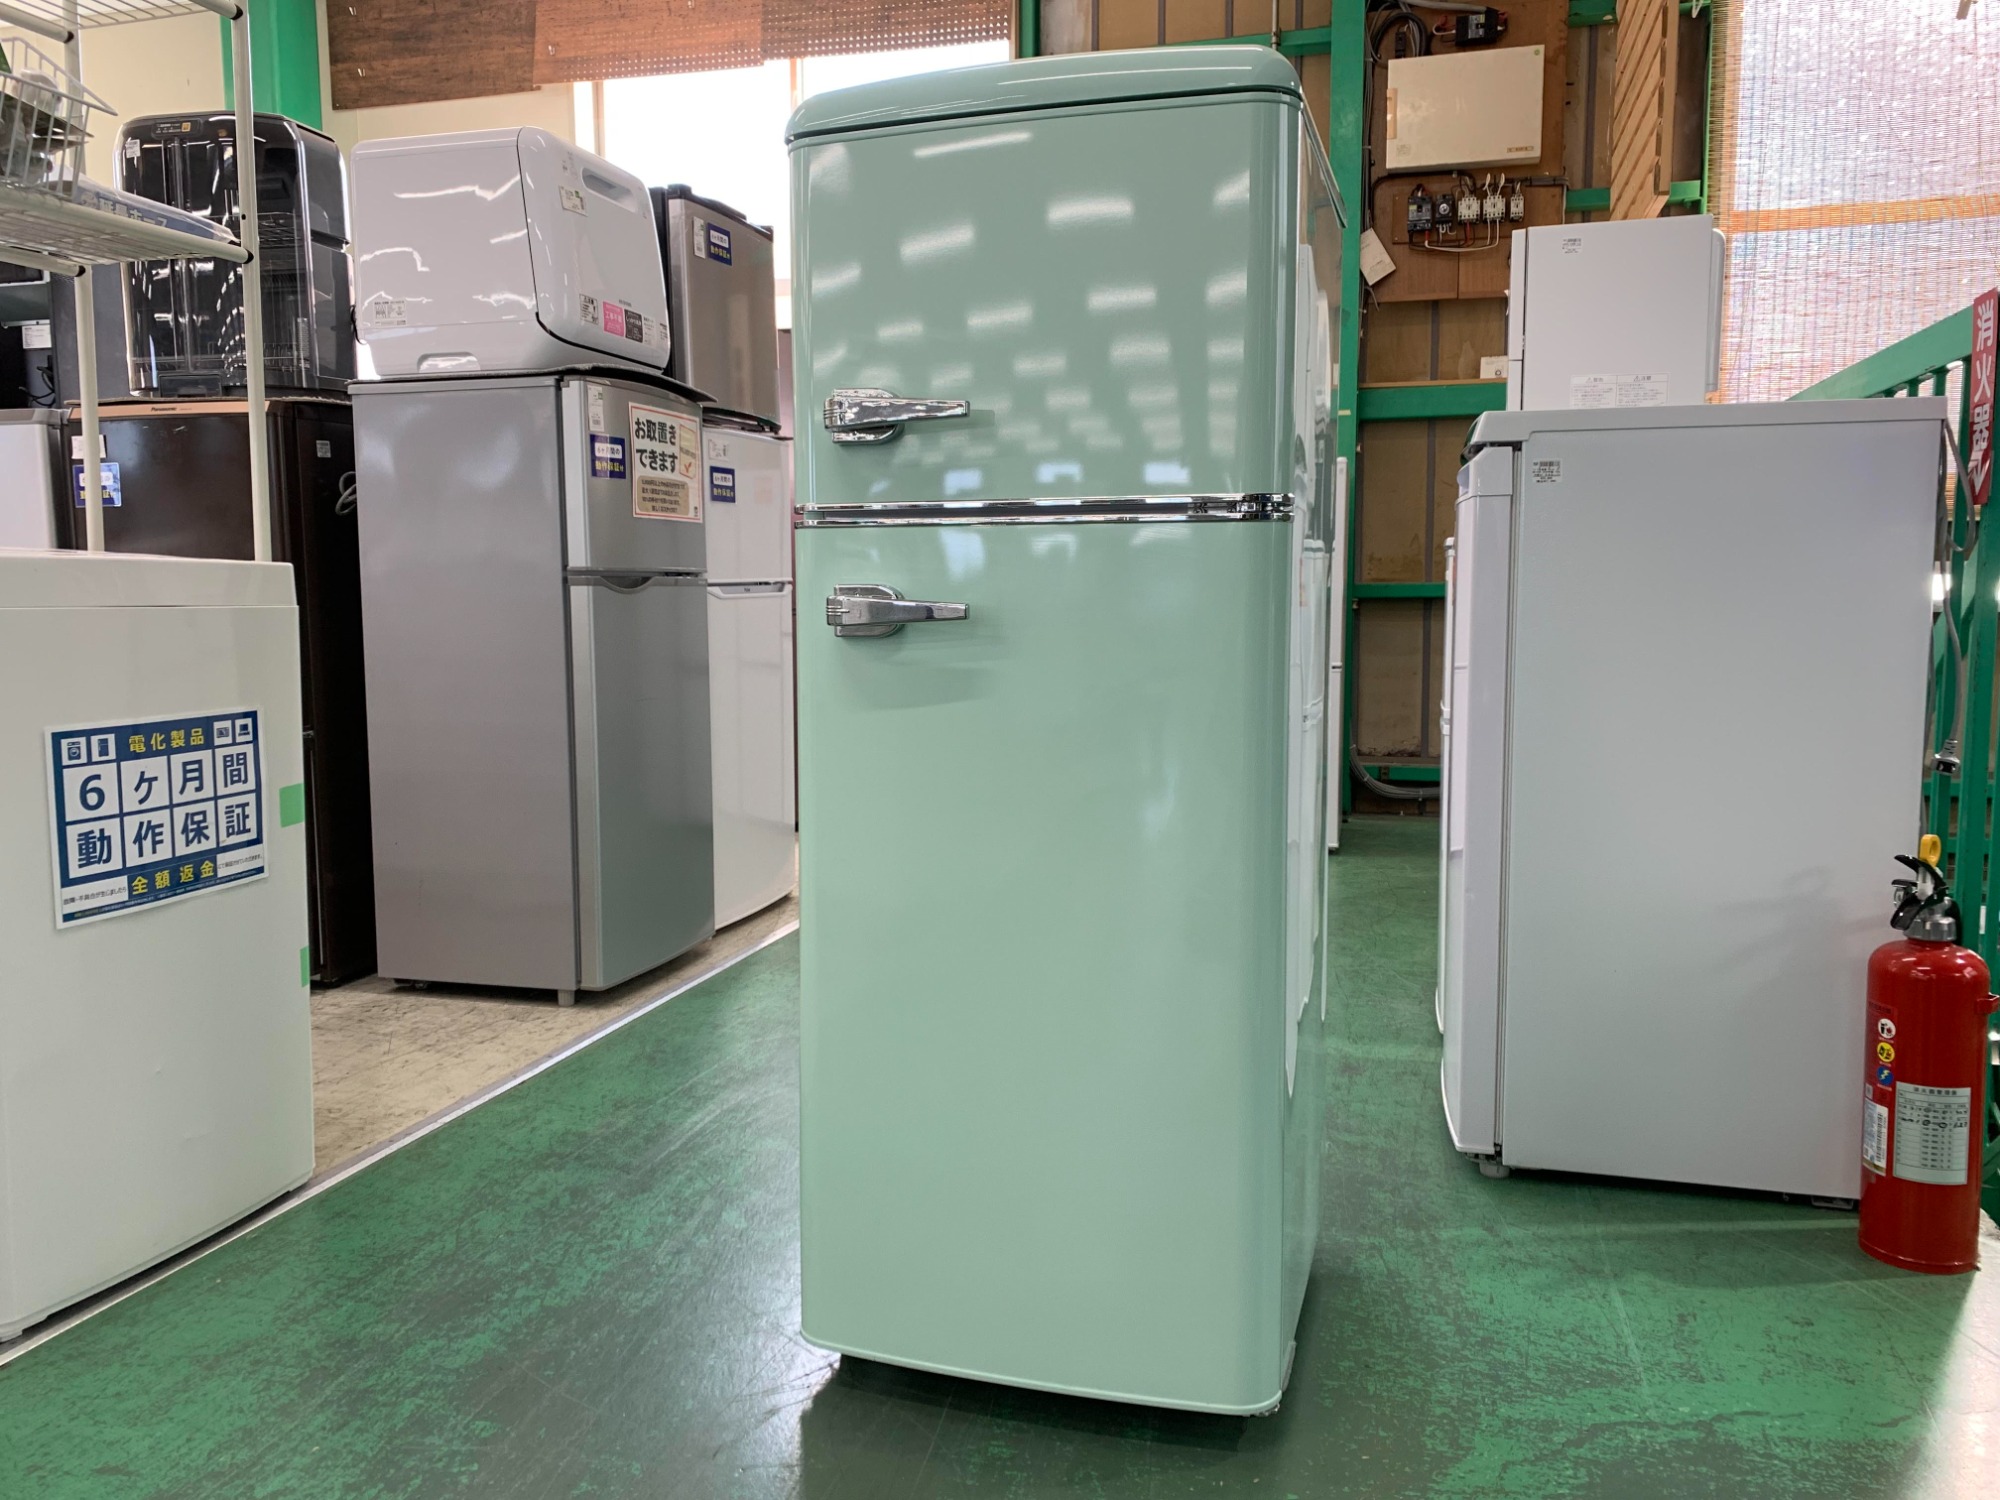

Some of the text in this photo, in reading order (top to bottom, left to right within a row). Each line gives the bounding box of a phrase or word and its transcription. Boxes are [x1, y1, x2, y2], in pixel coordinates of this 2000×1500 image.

[1973, 298, 1994, 450] 消火器
[635, 417, 677, 446] お取置き
[635, 448, 678, 473] できます
[128, 727, 206, 753] 電化製品
[76, 801, 251, 869] 動作保証
[131, 860, 216, 896] 全額返金
